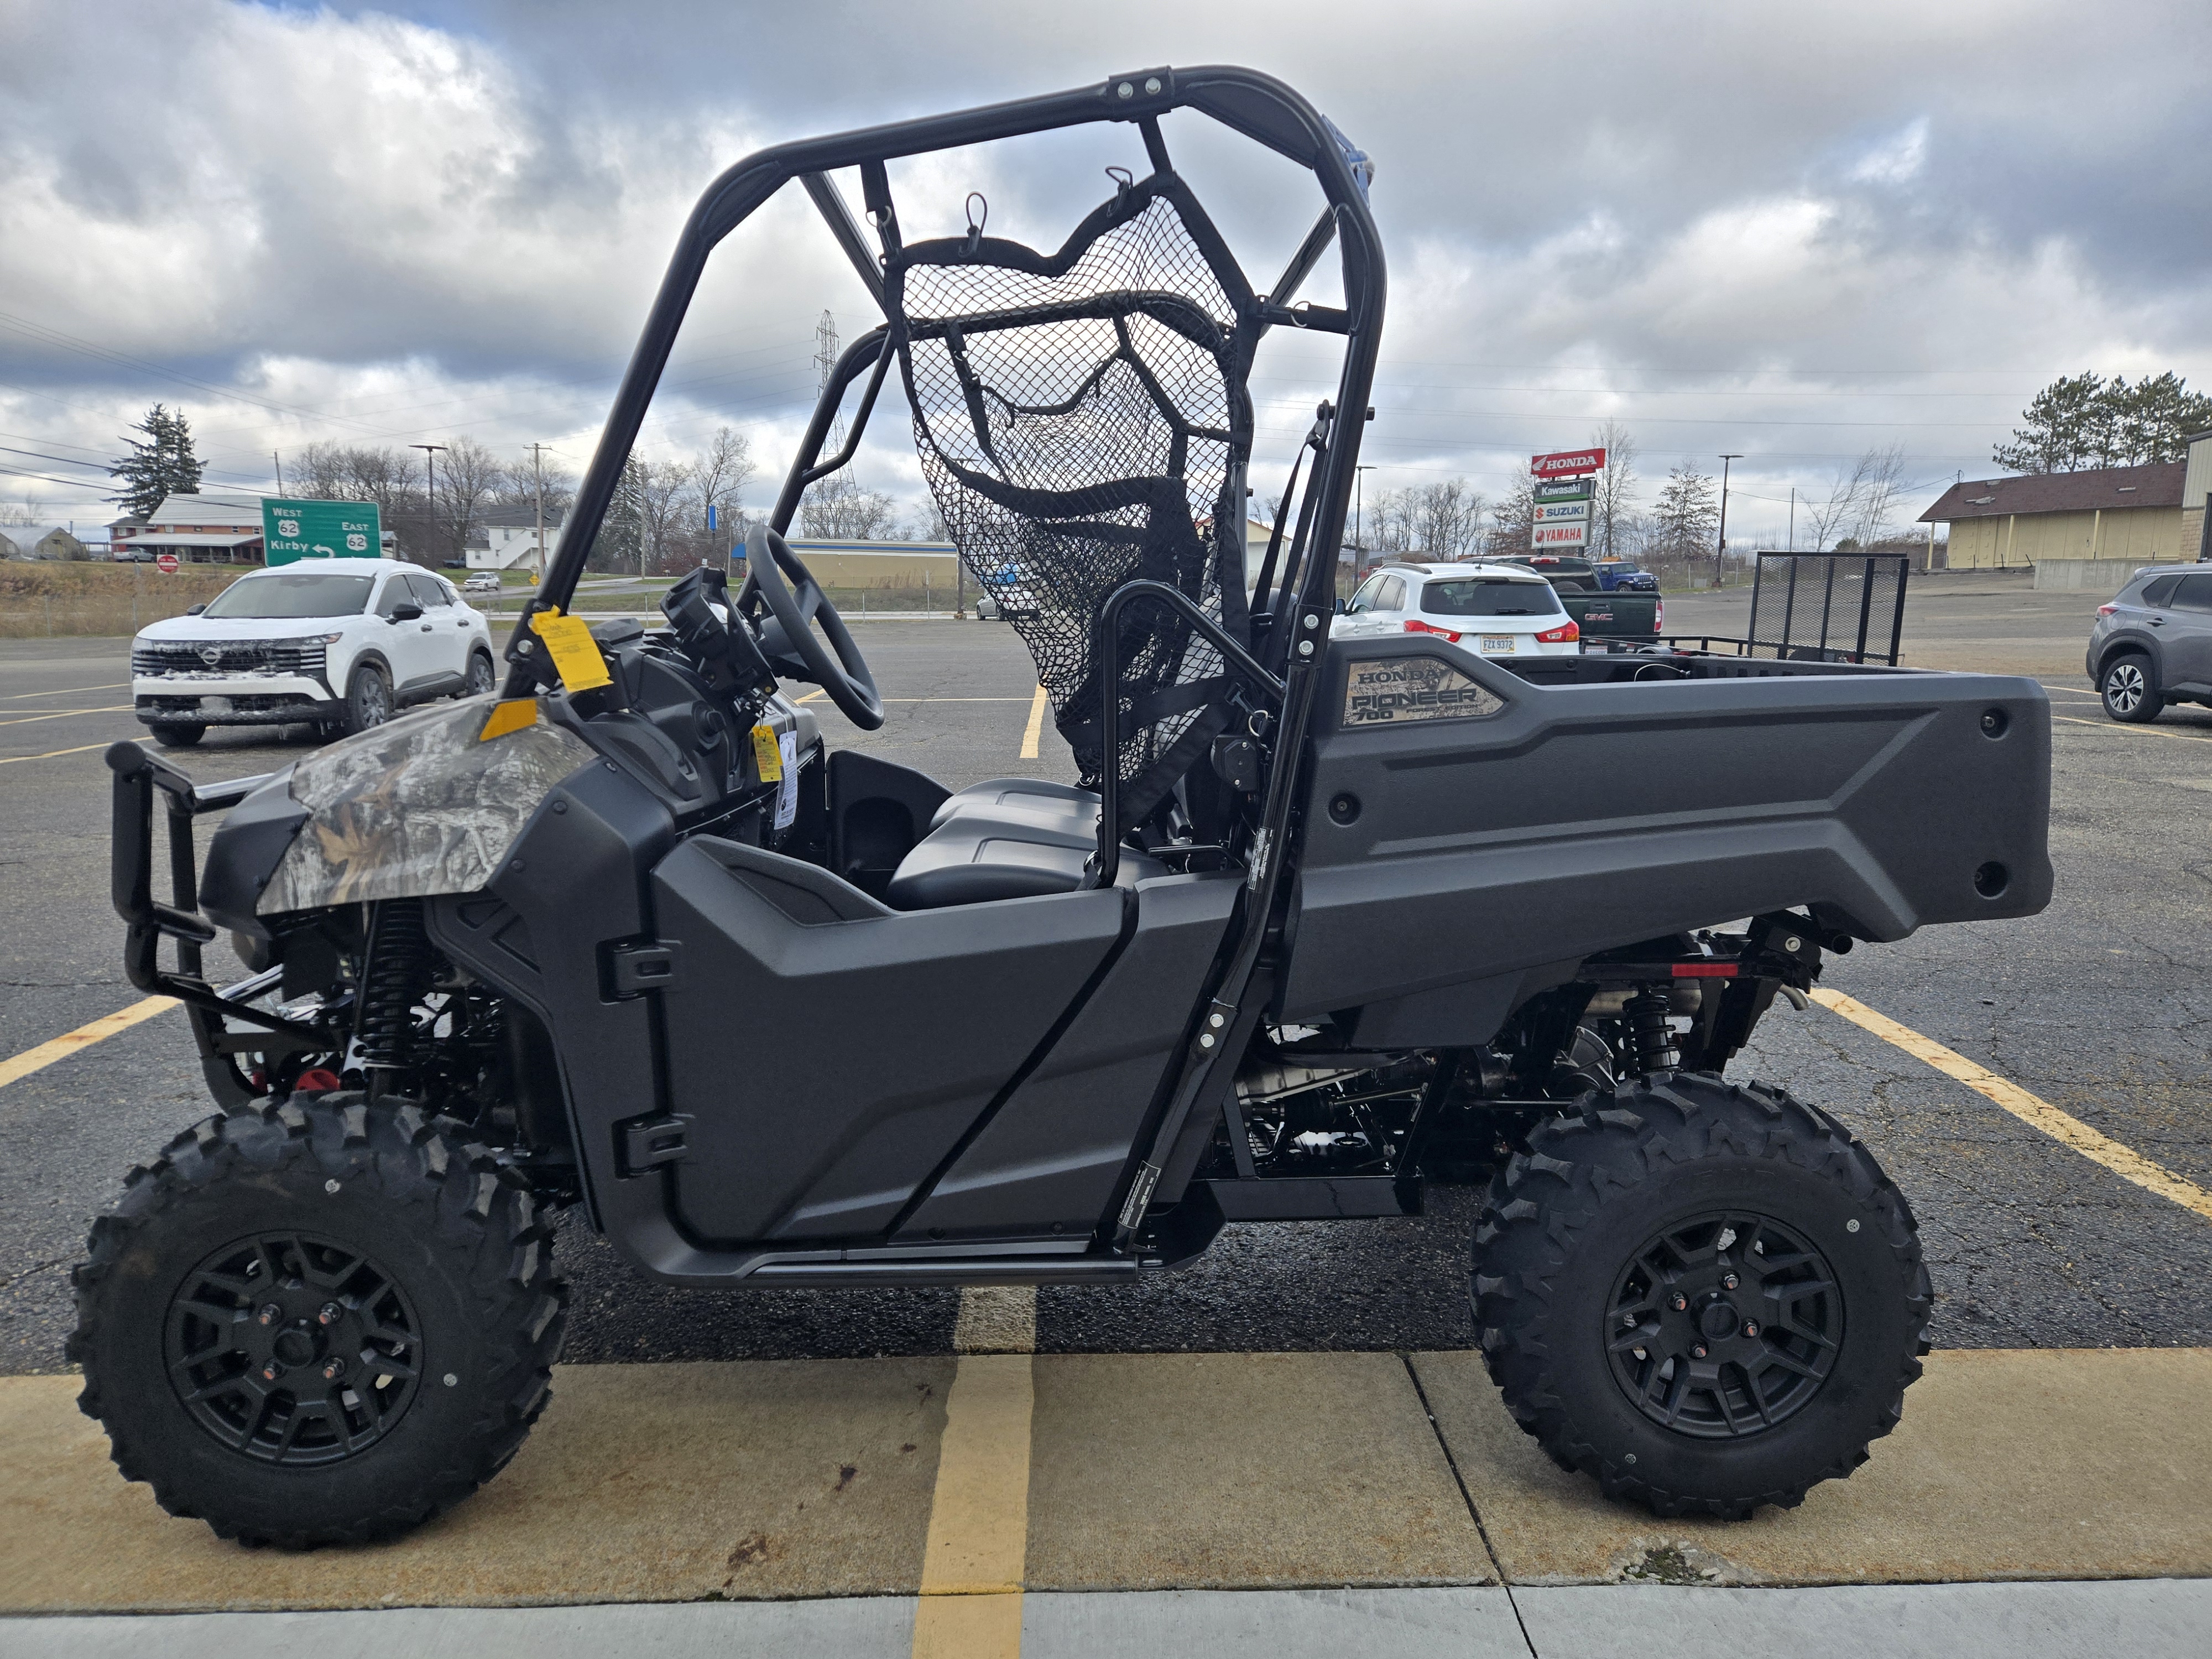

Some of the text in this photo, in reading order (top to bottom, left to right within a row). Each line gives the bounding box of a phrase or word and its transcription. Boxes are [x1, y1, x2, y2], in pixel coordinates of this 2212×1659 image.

[1546, 456, 1597, 470] HONDA
[1542, 483, 1580, 496] Kawasaki
[273, 507, 302, 517] WEST
[1546, 506, 1584, 517] SUZUKI
[280, 523, 297, 533] 62
[341, 521, 369, 531] EAST
[1546, 528, 1582, 542] YAMAHA
[270, 540, 309, 552] Kirby
[348, 538, 364, 547] 62
[1484, 640, 1513, 649] FZX 9372
[1358, 669, 1441, 684] HONDA
[1352, 688, 1477, 709] PIONEER
[1353, 710, 1394, 721] 700
